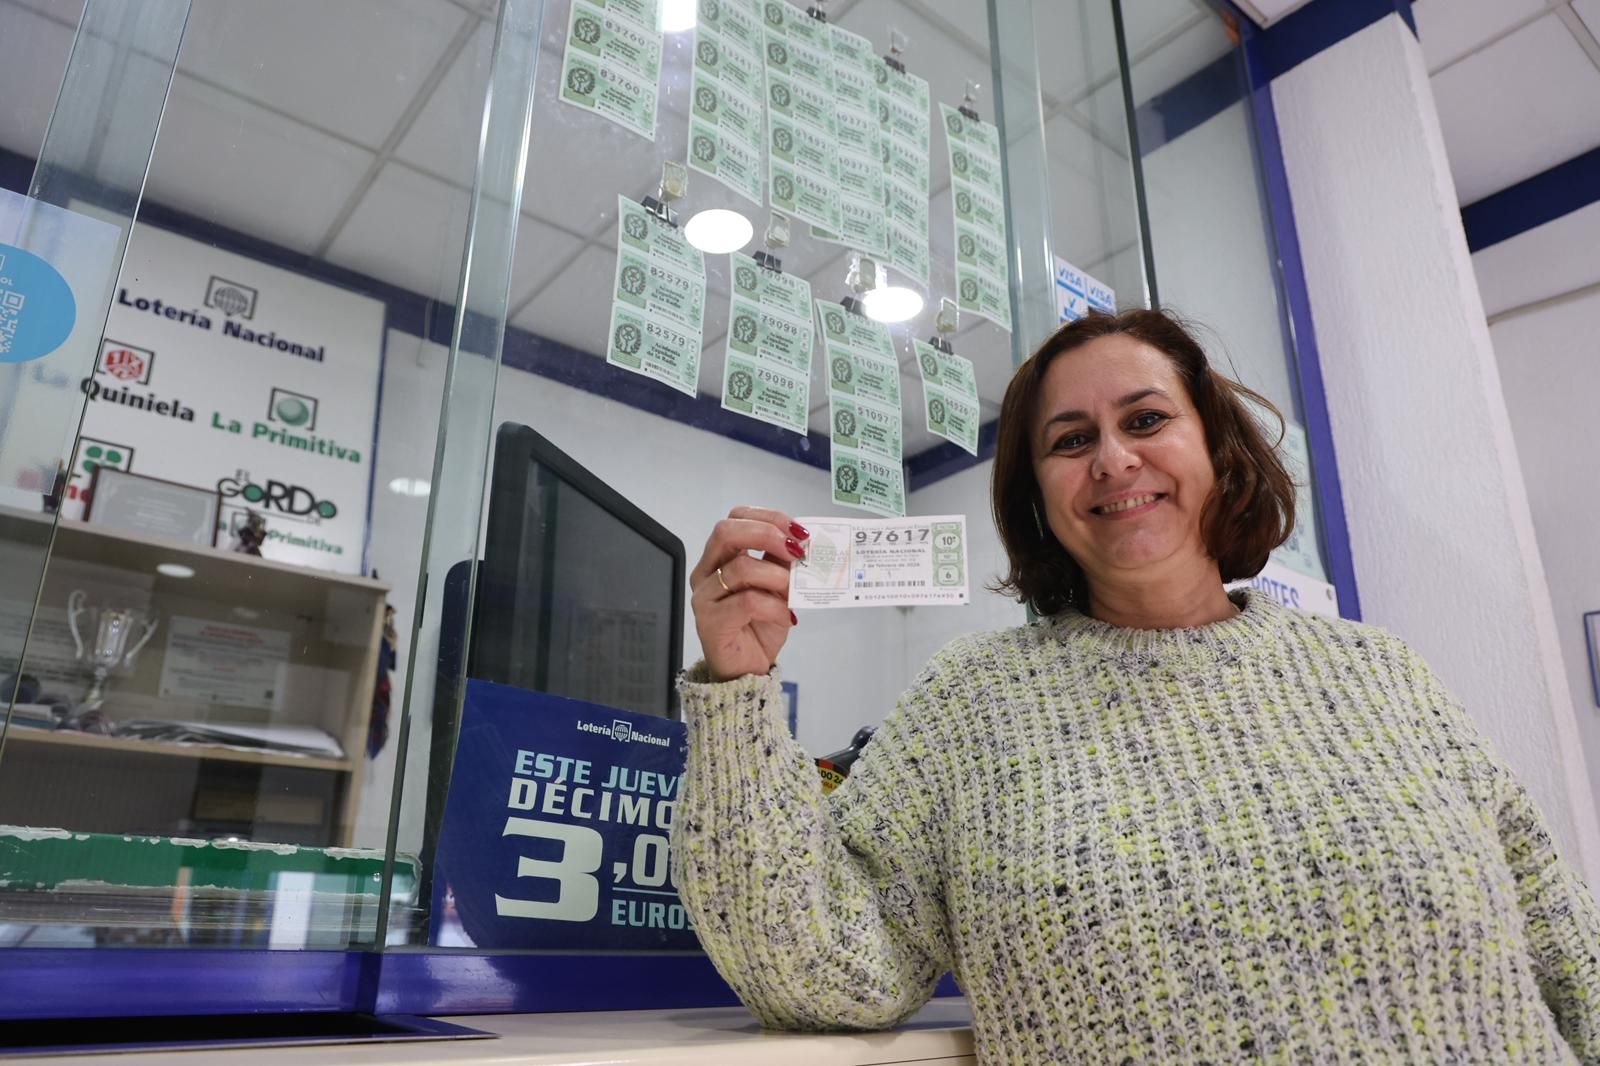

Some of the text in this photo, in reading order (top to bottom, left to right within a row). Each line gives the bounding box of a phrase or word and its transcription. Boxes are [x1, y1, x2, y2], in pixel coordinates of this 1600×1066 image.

[600, 69, 640, 95] 83760
[650, 266, 689, 290] 82579
[118, 288, 324, 362] Lotería Nacional
[647, 324, 685, 346] 82579
[762, 313, 797, 335] 79098
[758, 369, 794, 390] 79098
[80, 377, 195, 422] Quiniela
[858, 406, 889, 424] 51097
[212, 412, 361, 463] La Primitiva
[861, 461, 890, 478] 51097
[855, 528, 929, 543] 97617
[577, 720, 670, 747] Lotería Nacional
[514, 749, 684, 798] ESTE JUEV
